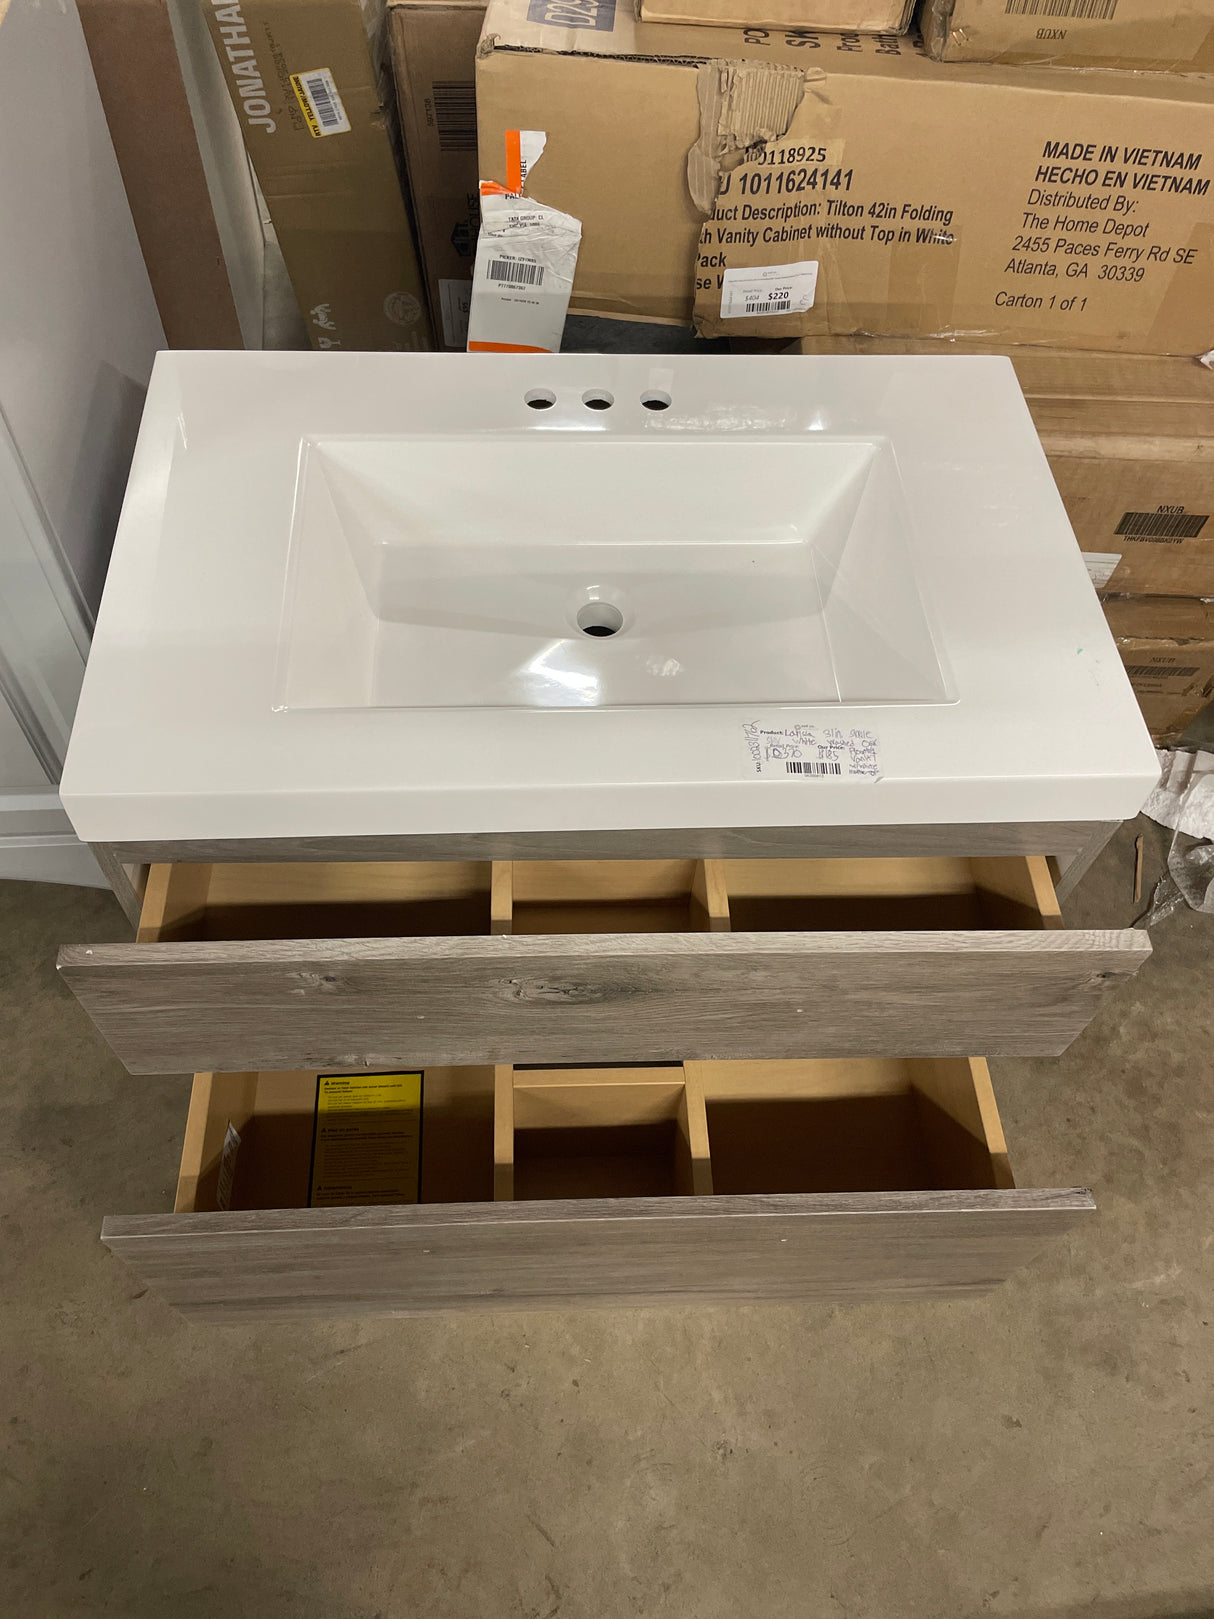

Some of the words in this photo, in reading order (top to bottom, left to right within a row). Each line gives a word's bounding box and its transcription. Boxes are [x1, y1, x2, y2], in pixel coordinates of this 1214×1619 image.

[1036, 28, 1067, 40] NXUB
[1042, 141, 1096, 161] MADE
[1099, 145, 1118, 163] IN
[1123, 147, 1202, 171] VIETNAM
[739, 167, 854, 196] 1011624141
[1035, 165, 1098, 186] HECHO
[1102, 170, 1128, 188] EN
[1133, 173, 1211, 196] VIETNAM
[741, 200, 822, 223] Description:
[826, 199, 864, 218] Tilton
[867, 202, 897, 219] 42in
[900, 204, 954, 226] Folding
[1027, 188, 1111, 211] Distributed
[1112, 195, 1139, 217] By:
[717, 227, 760, 247] Vanity
[762, 223, 813, 243] Cabinet
[815, 222, 867, 241] without
[870, 225, 895, 245] Top
[898, 226, 912, 243] in
[1022, 212, 1050, 230] The
[1053, 215, 1099, 234] Home
[1102, 218, 1150, 240] Depot
[1011, 235, 1052, 253] 2455
[1053, 238, 1101, 257] Paces
[1103, 241, 1145, 264] Ferry
[1146, 245, 1171, 263] Rd
[1172, 248, 1199, 265] SE
[1004, 257, 1060, 279] Atlanta,
[1065, 262, 1089, 279] GA
[1097, 264, 1146, 283] 30339
[768, 291, 790, 301] $220
[994, 291, 1043, 309] Carton
[1049, 295, 1057, 310] 1
[1060, 296, 1078, 311] of
[1080, 297, 1089, 312] 1
[1156, 504, 1185, 515] NXUB
